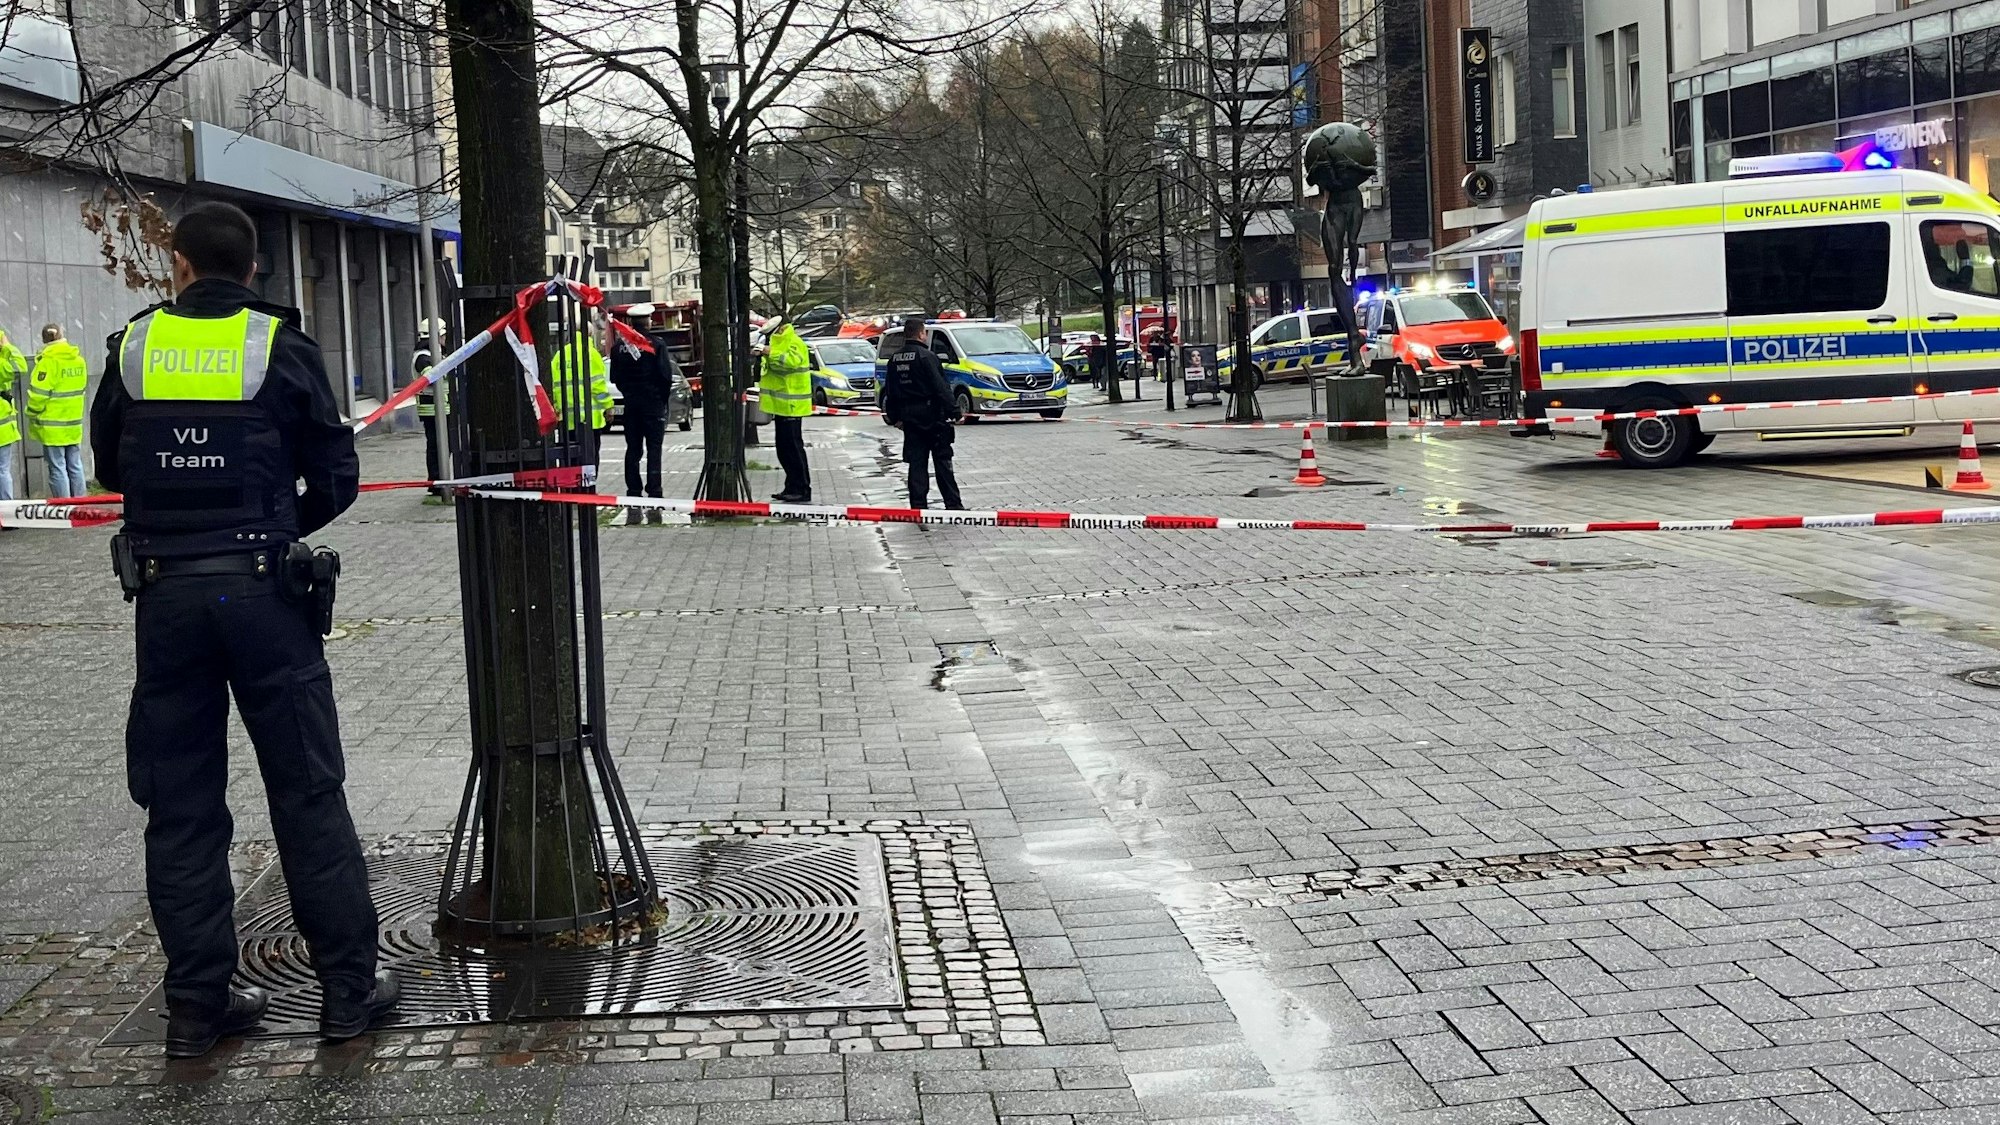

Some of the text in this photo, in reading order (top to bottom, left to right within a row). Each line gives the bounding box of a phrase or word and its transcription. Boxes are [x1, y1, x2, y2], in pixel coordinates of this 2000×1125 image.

[1744, 198, 1882, 218] UNFALLAUFNAHME
[1744, 336, 1847, 361] POLIZEI
[149, 348, 238, 374] POLIZEI
[173, 427, 209, 444] VU
[156, 452, 225, 468] Team
